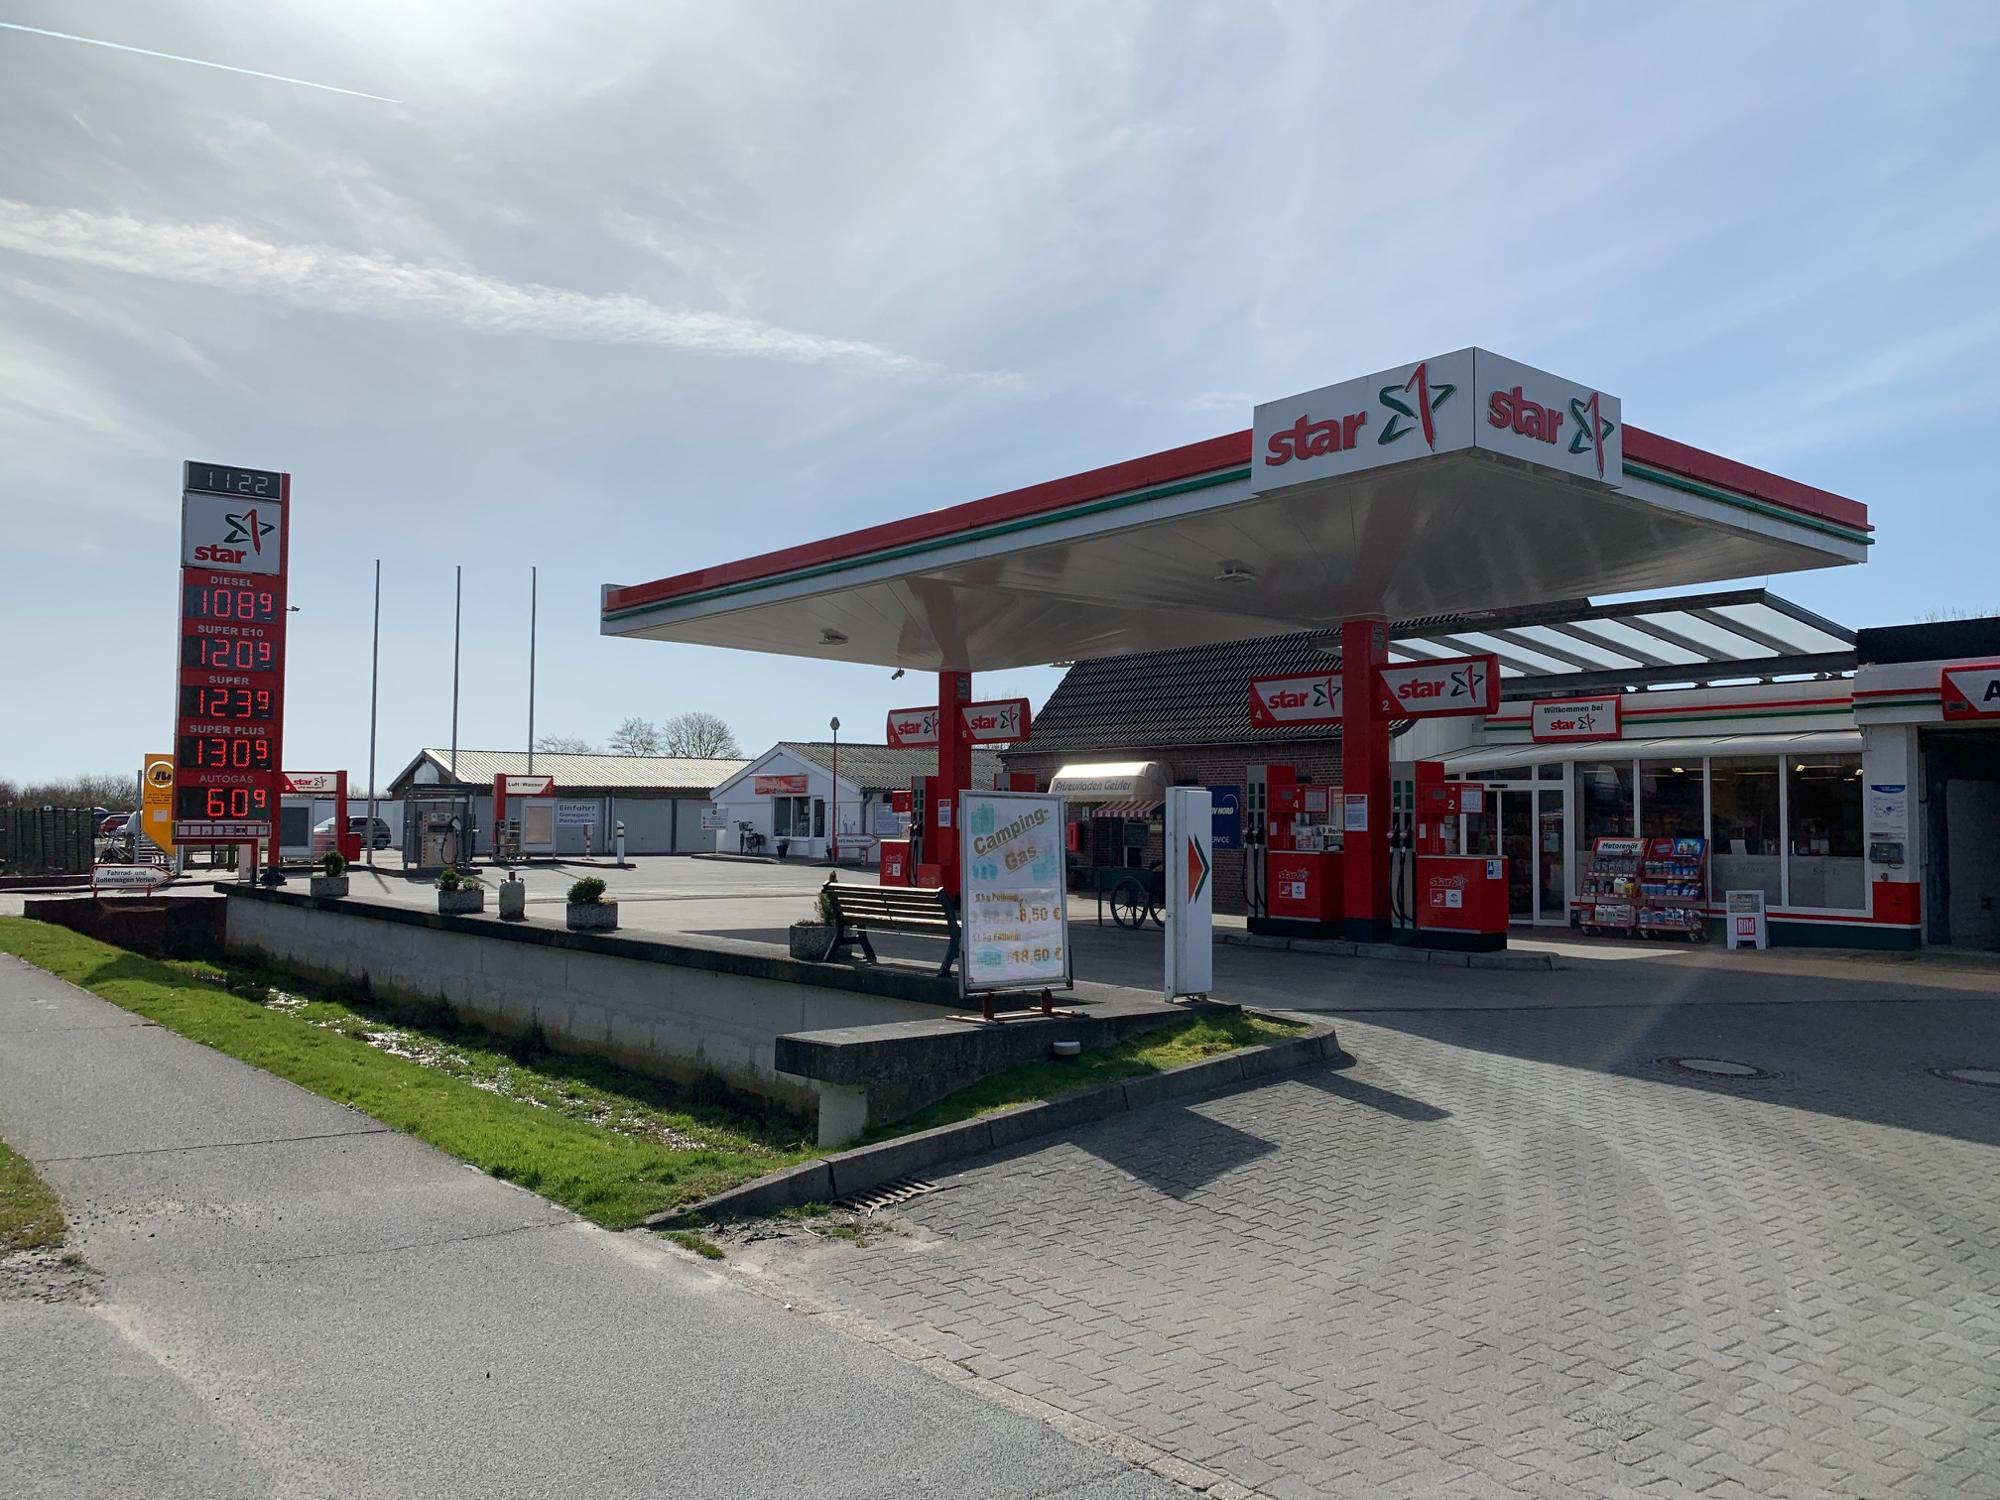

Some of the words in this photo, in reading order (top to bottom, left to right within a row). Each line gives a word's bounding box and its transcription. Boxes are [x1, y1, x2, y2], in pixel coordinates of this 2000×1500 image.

[1487, 386, 1564, 445] star
[1265, 410, 1368, 467] star
[194, 544, 247, 564] star
[210, 575, 253, 587] DIESEL
[197, 624, 238, 636] SUPER
[242, 627, 264, 637] E10
[208, 675, 249, 685] SUPER
[1397, 678, 1446, 700] star
[1268, 689, 1309, 709] star
[1382, 700, 1390, 711] 2
[1544, 705, 1589, 714] Willkommen
[1255, 709, 1262, 720] 4
[898, 720, 921, 735] star
[971, 715, 997, 730] star
[1550, 719, 1576, 731] star
[189, 724, 230, 734] SUPER
[234, 726, 265, 735] PLUS
[199, 775, 254, 783] AUTOGAS
[559, 804, 596, 812] Einfahrt
[1293, 799, 1299, 808] 4
[1448, 799, 1455, 810] 2
[1217, 807, 1234, 815] NORD
[973, 807, 1049, 855] Camping-
[1602, 841, 1639, 849] Motorenöl
[1004, 845, 1037, 871] Gas
[1053, 907, 1061, 921] €
